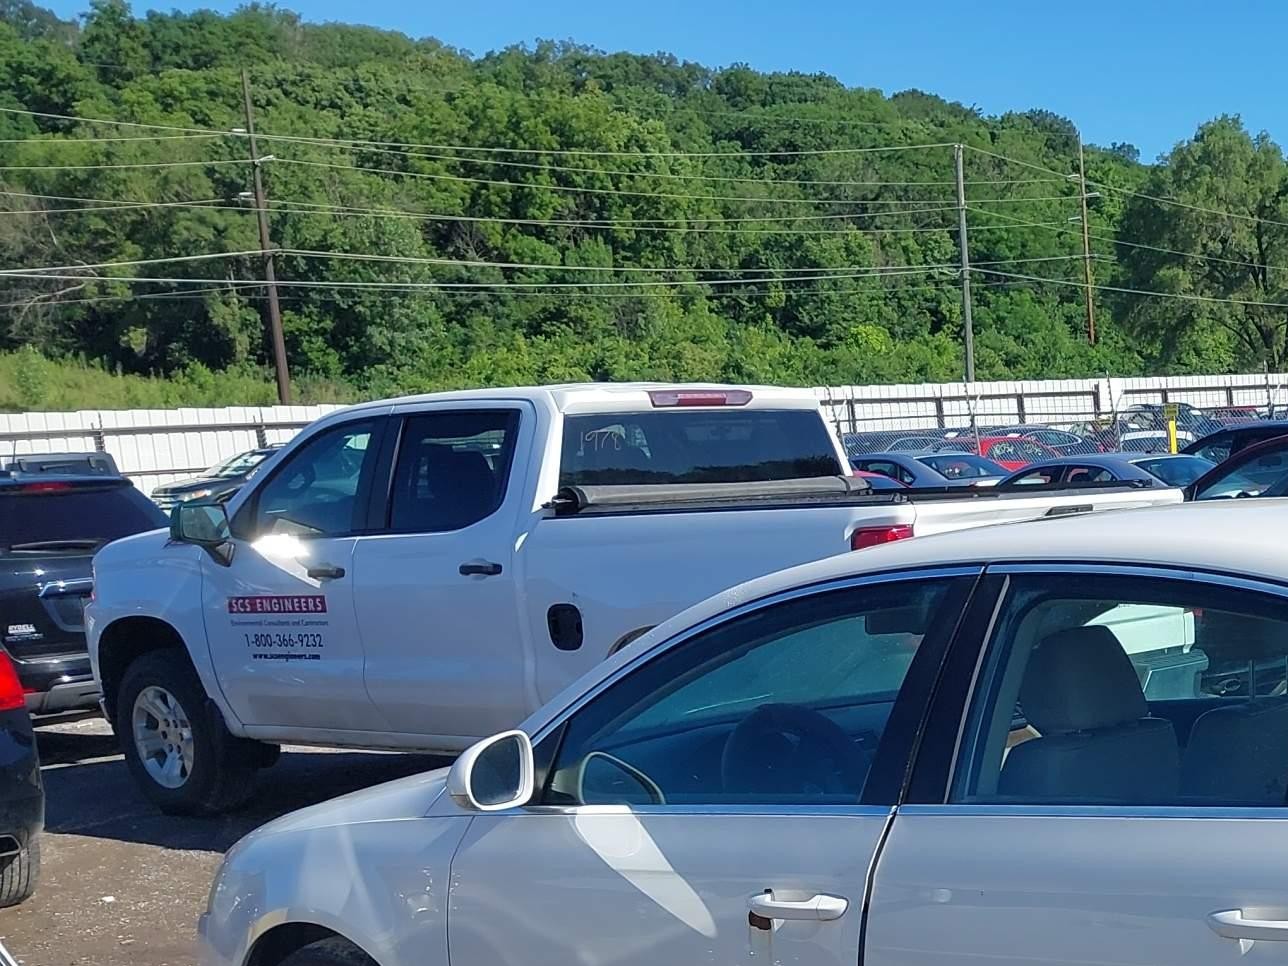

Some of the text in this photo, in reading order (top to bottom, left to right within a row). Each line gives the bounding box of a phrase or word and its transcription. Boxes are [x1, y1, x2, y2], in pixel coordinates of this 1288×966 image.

[231, 597, 323, 612] SCS ENGINEERS
[244, 633, 324, 648] 1-800-366-9232
